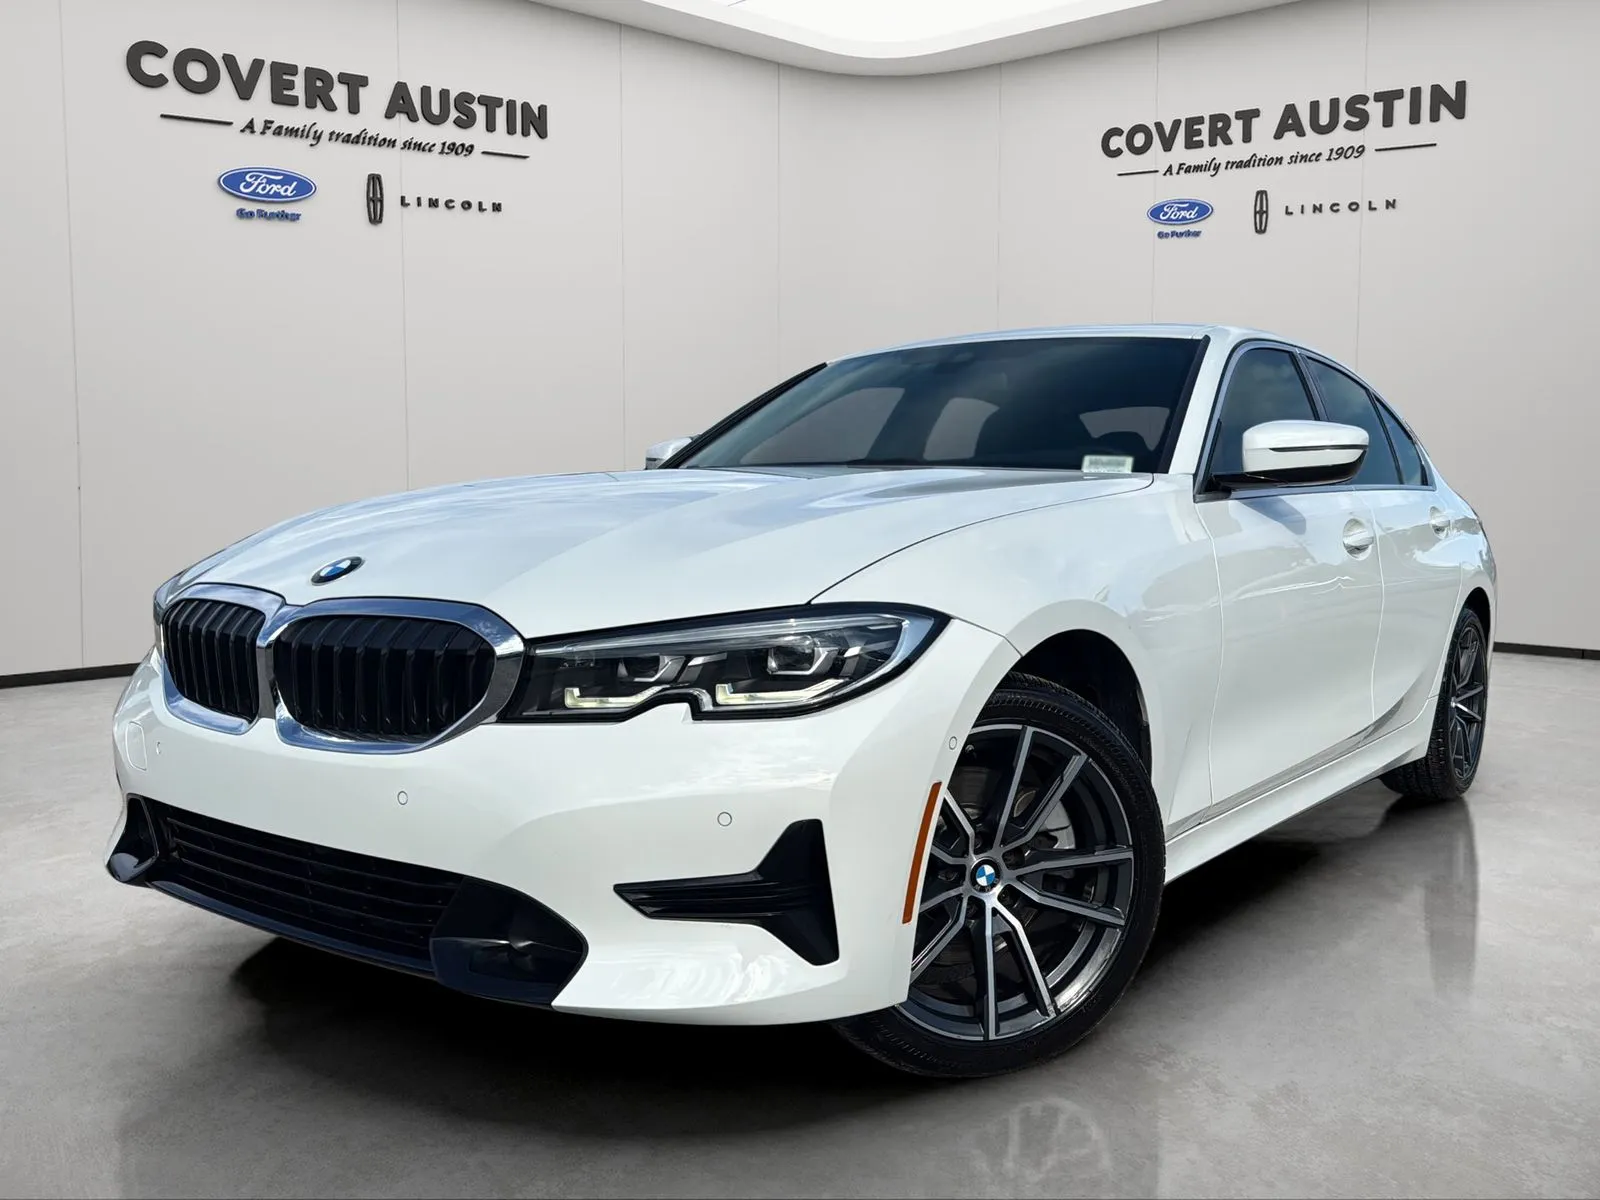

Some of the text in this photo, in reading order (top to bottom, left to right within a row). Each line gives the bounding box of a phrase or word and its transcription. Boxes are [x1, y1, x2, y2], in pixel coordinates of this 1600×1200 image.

[125, 40, 549, 139] COVERT AUSTIN
[1100, 80, 1467, 159] COVERT AUSTIN
[239, 117, 475, 157] A Family tradition since 1909
[1163, 144, 1366, 178] A Family tradition since 1909
[239, 172, 298, 197] Ford
[400, 195, 503, 213] LINCOLN
[1160, 203, 1199, 220] Ford
[1284, 198, 1397, 216] LINCOLN
